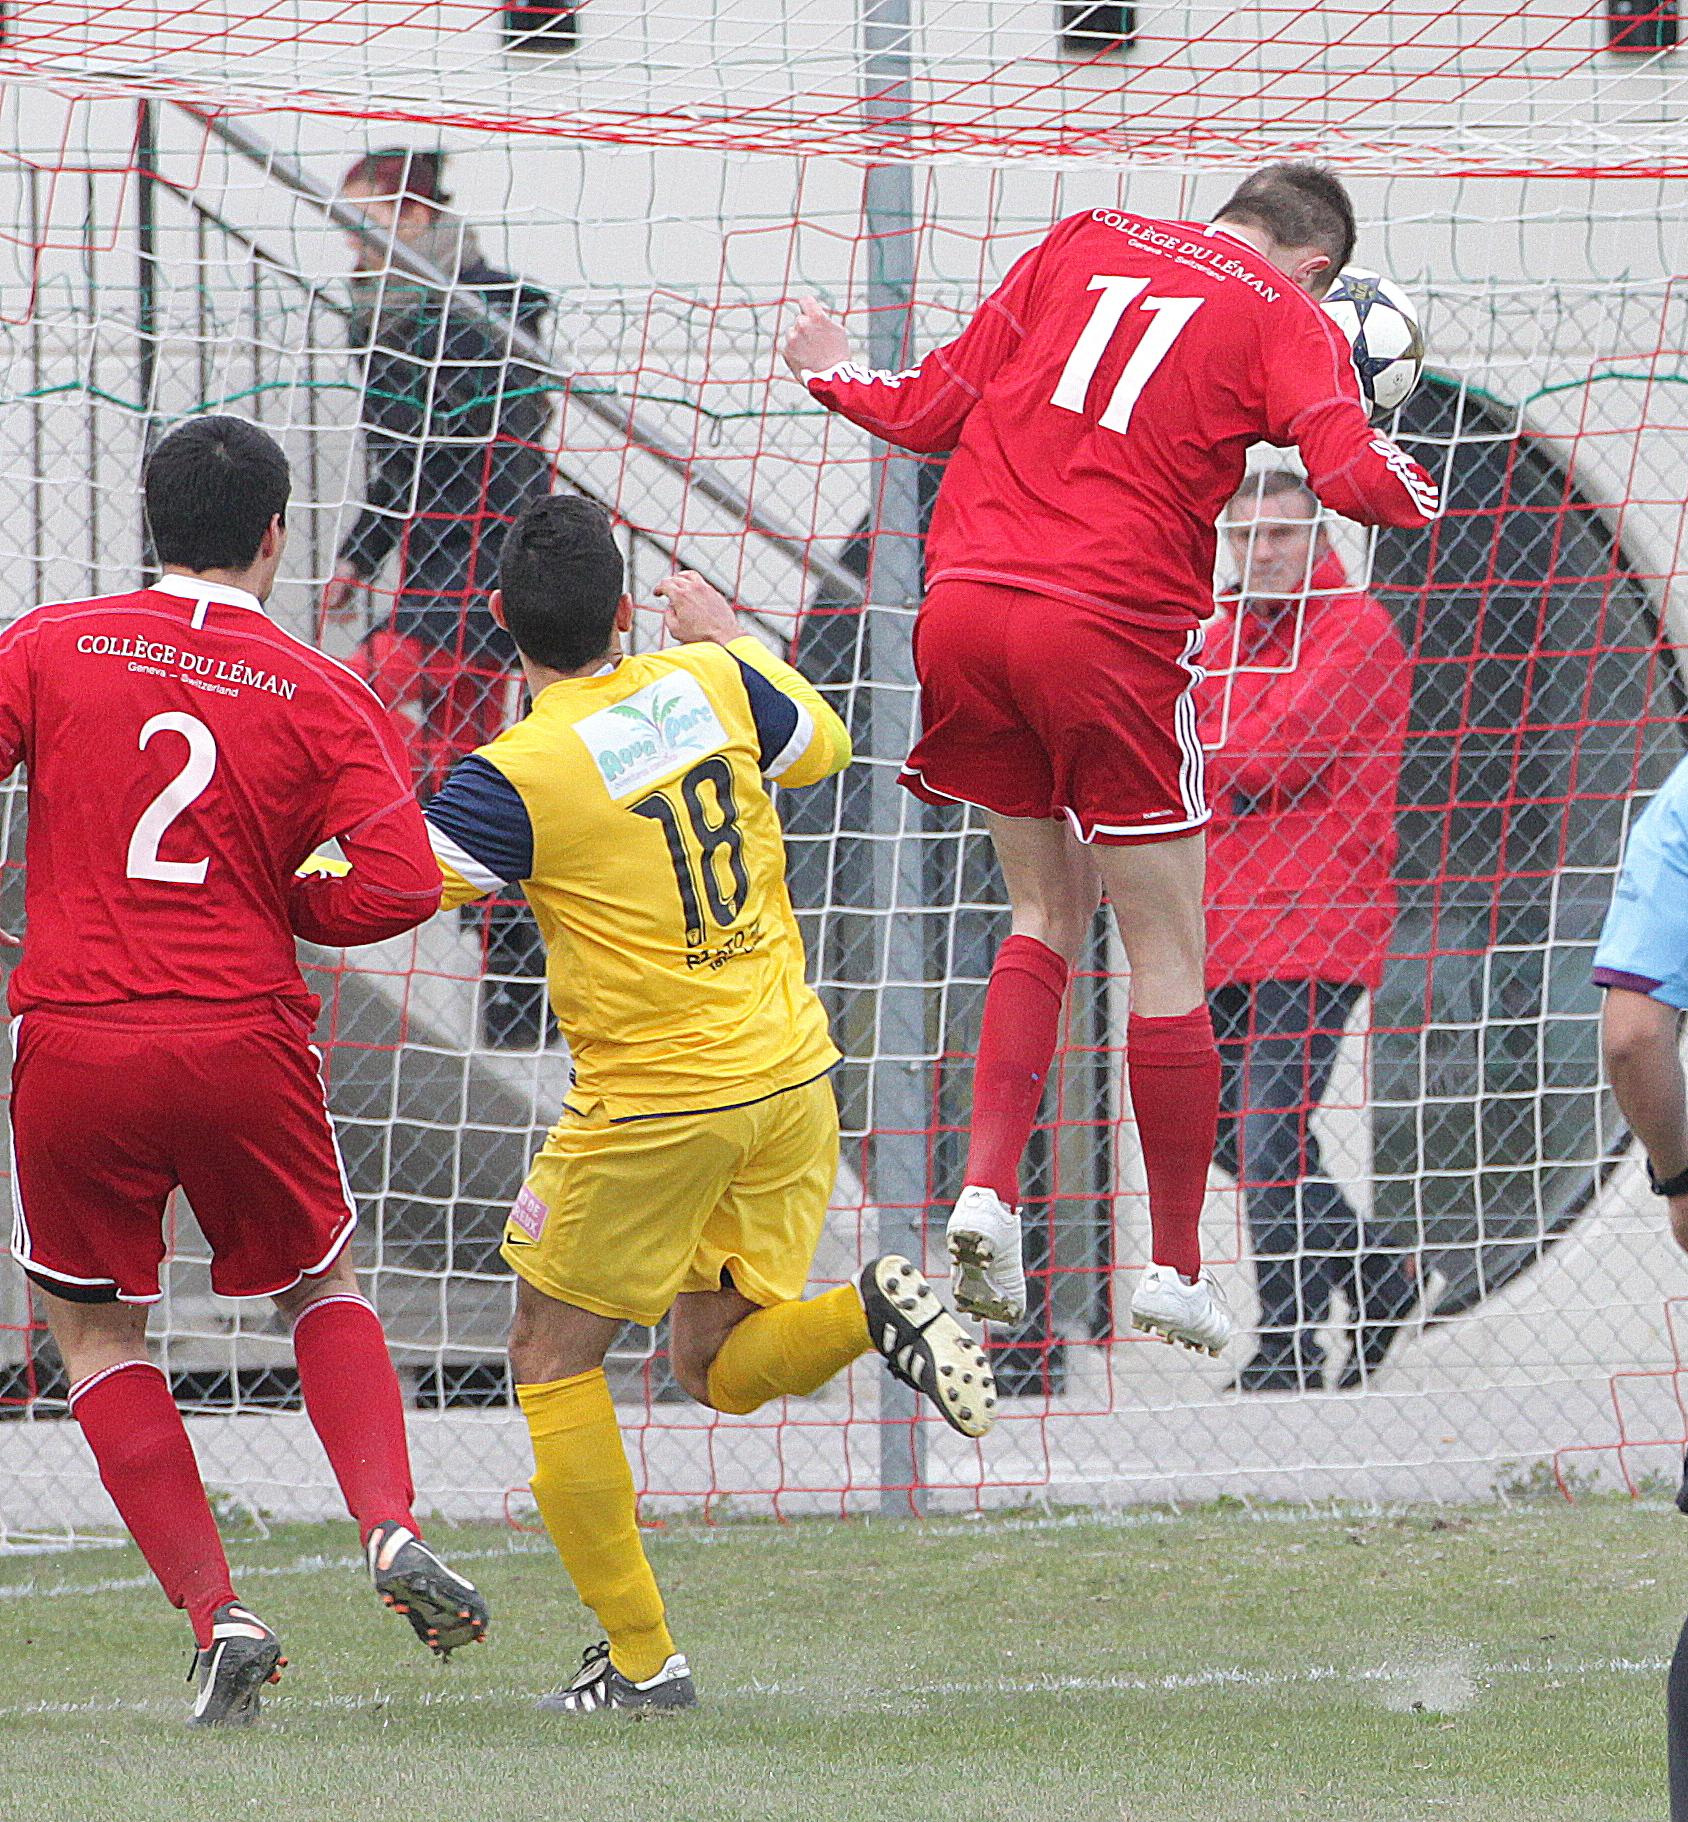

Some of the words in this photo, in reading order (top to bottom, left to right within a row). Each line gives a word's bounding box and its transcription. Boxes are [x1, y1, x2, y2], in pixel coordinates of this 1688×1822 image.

[1092, 208, 1181, 250] COLLÈGE
[1178, 242, 1215, 260] DU
[1209, 260, 1280, 303] LÉMAN
[1127, 239, 1163, 255] Geneva
[1174, 255, 1226, 282] Switzerland
[1049, 274, 1206, 435] 11
[77, 634, 177, 665] COLLÈGE
[179, 652, 215, 675] DU
[215, 659, 298, 701] LÉMAN
[127, 661, 167, 678] Geneva
[180, 673, 240, 698] Switzerland
[598, 740, 657, 782] Aqua
[665, 705, 713, 749] Parc
[126, 711, 218, 885] 2
[625, 753, 752, 949] 18
